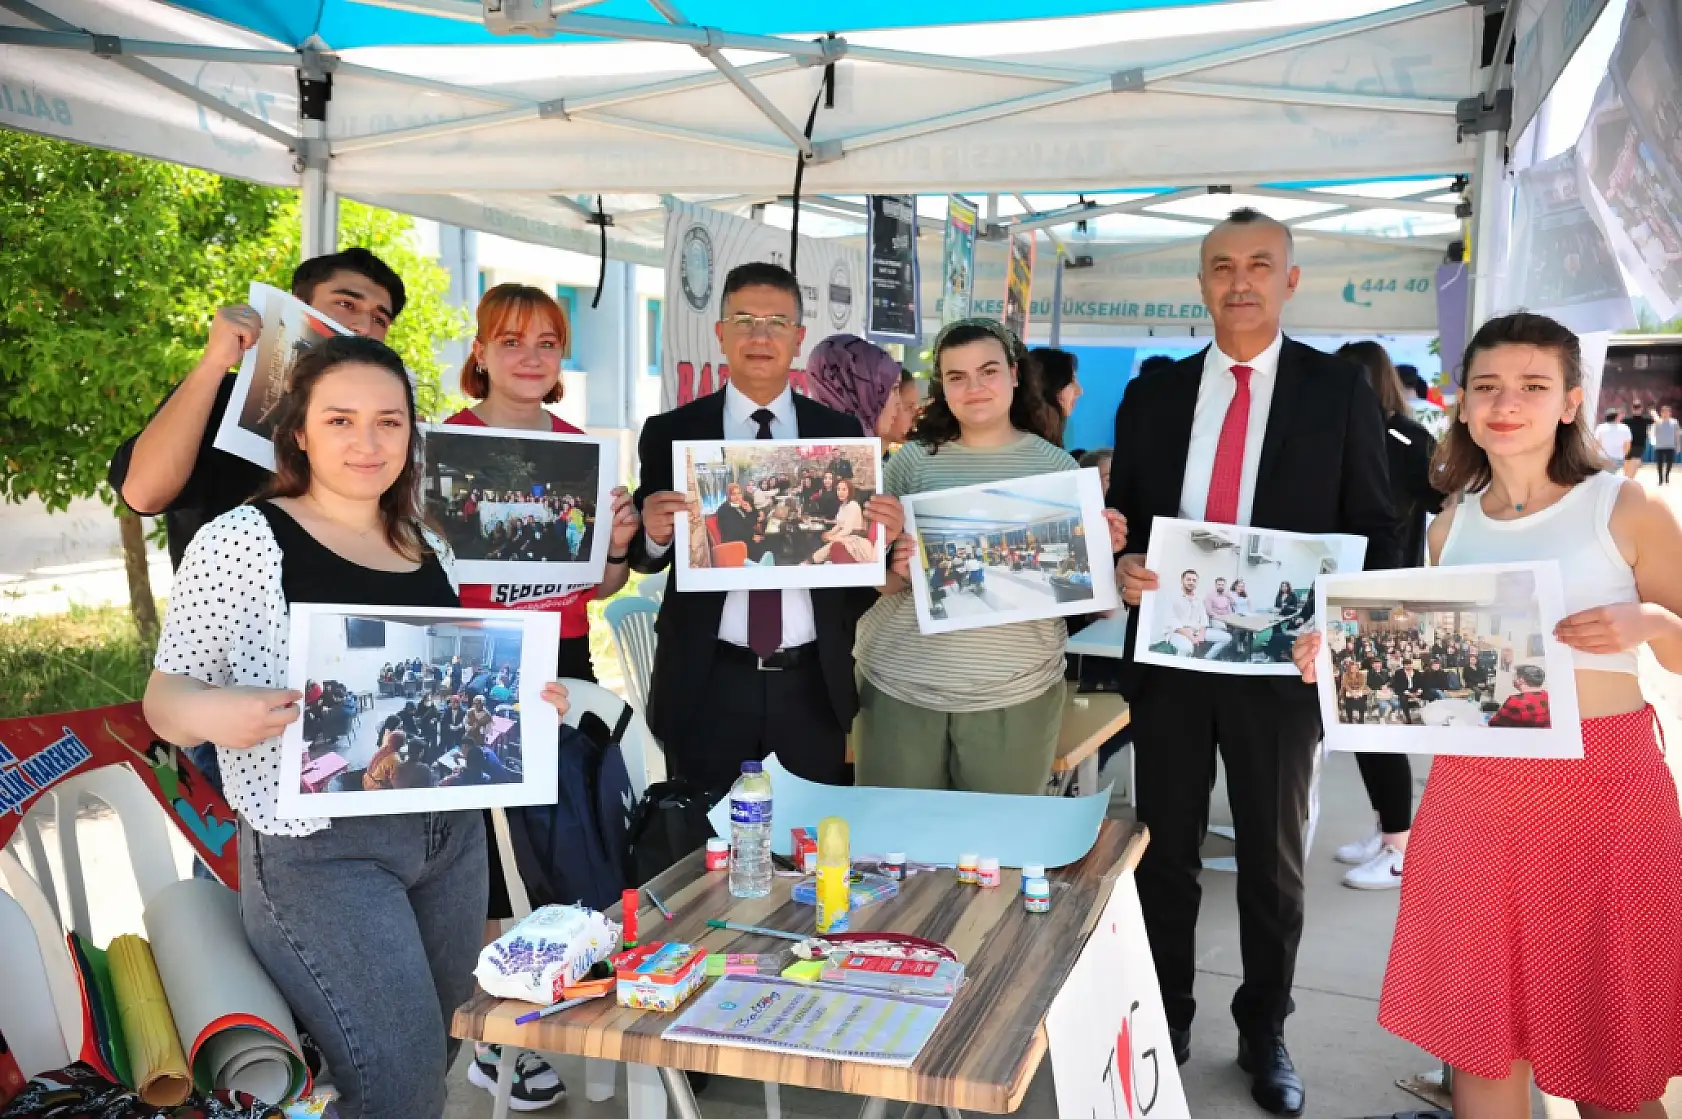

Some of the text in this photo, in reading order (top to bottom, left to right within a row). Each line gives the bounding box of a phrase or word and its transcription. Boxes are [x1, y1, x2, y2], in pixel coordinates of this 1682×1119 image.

[1361, 277, 1430, 293] 444 40
[1030, 297, 1140, 317] BÜÜKŞEHİR
